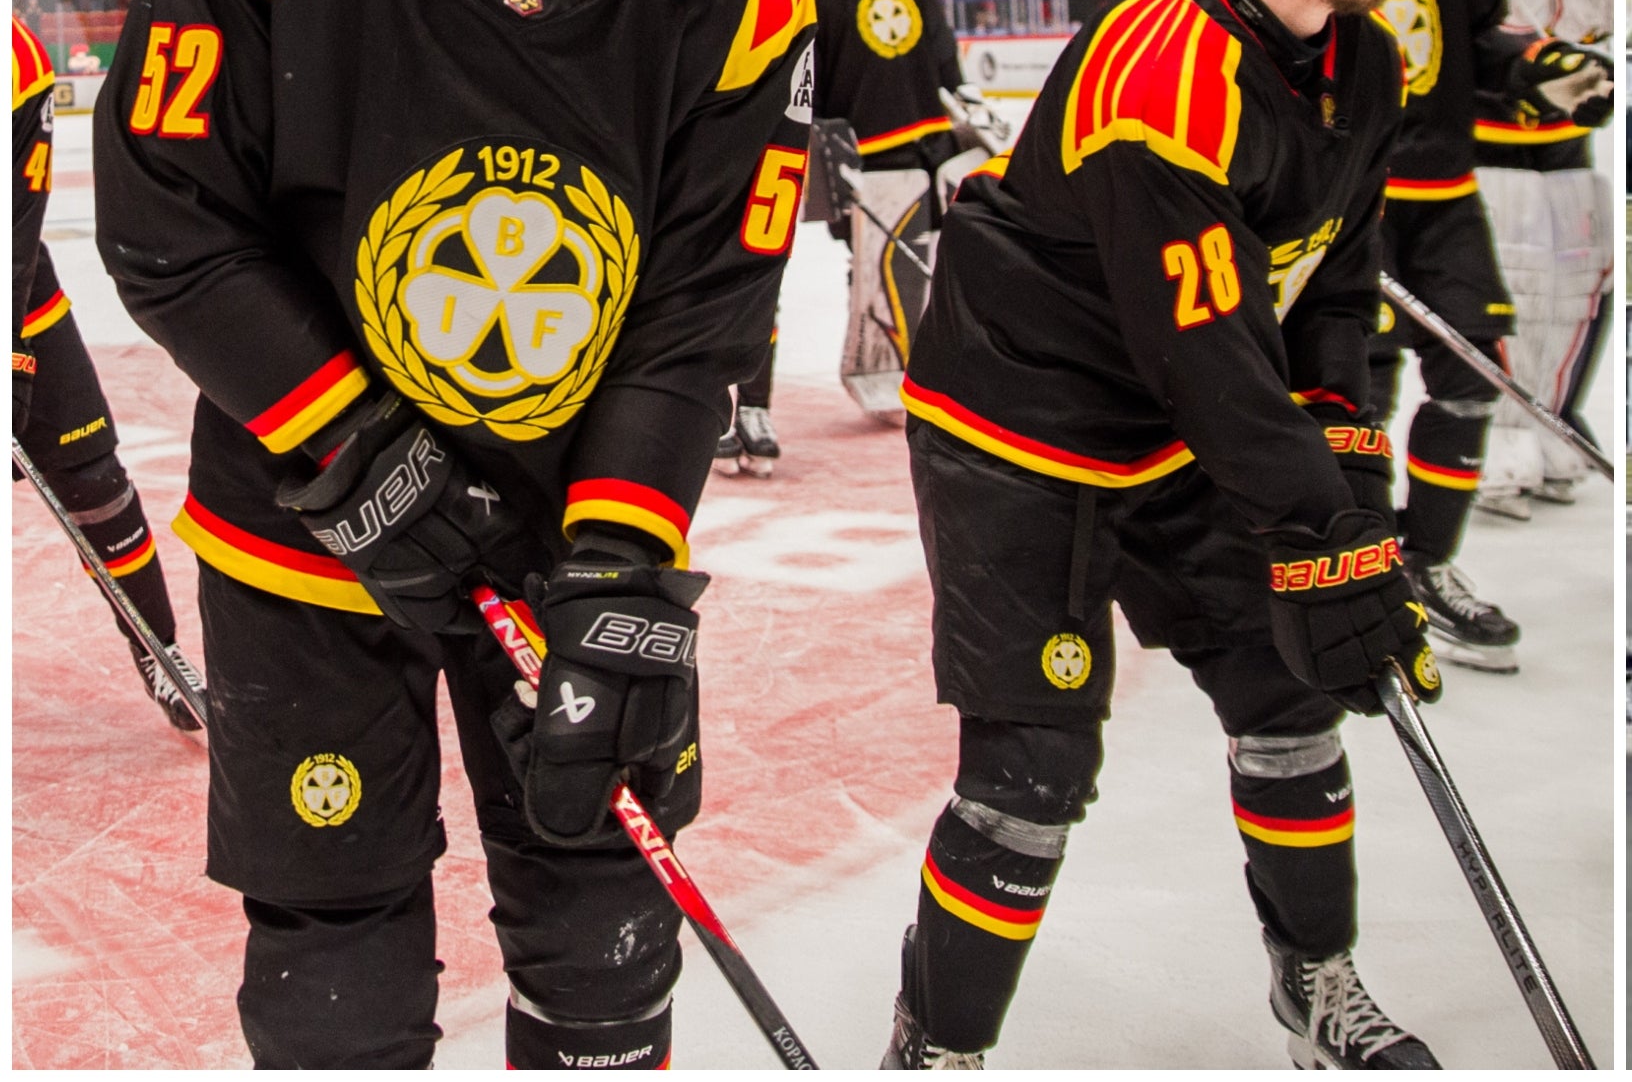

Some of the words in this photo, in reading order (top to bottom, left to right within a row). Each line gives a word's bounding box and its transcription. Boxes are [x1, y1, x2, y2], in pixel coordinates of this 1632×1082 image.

[129, 22, 224, 138] 52
[21, 140, 52, 194] 4
[477, 146, 561, 190] 1912
[740, 143, 810, 256] 5
[495, 216, 526, 257] B
[1162, 222, 1242, 332] 28
[440, 295, 457, 335] I
[531, 309, 563, 349] F
[312, 428, 446, 555] AUER
[313, 752, 336, 764] 1912
